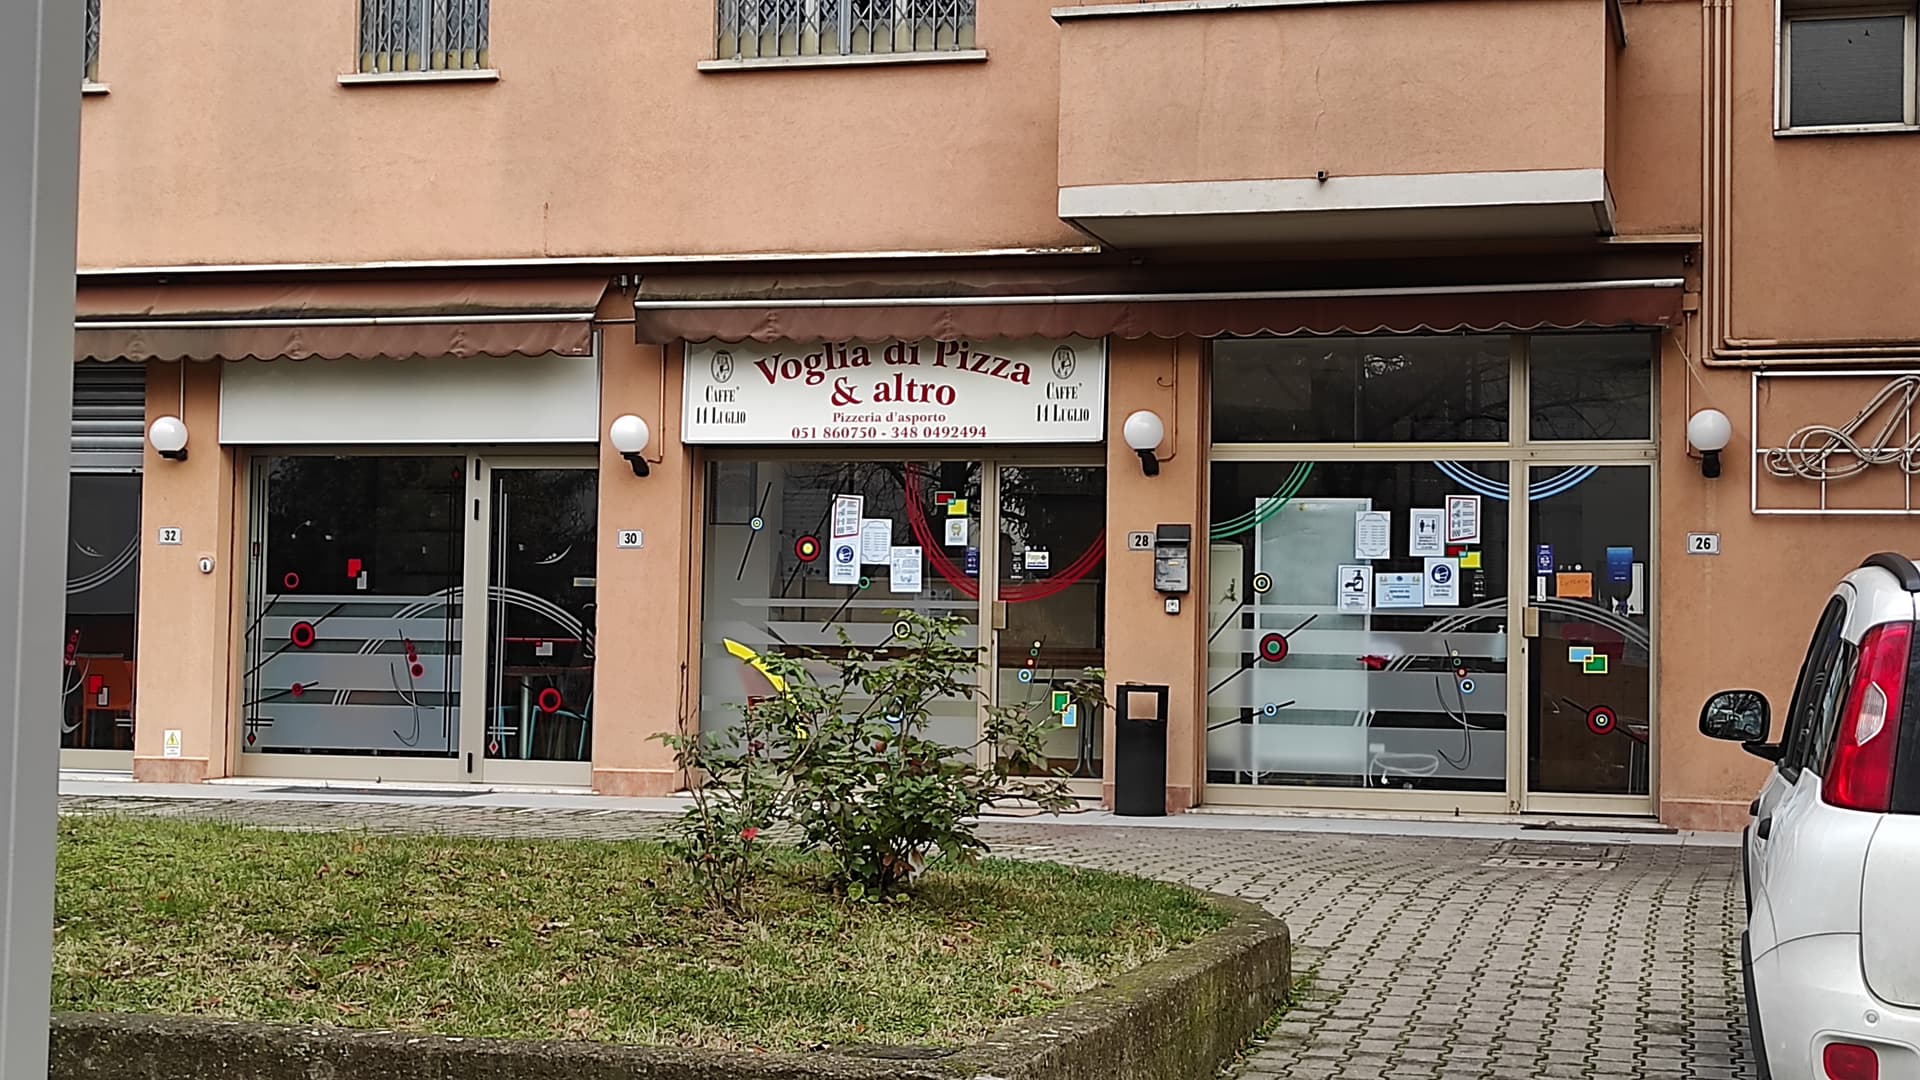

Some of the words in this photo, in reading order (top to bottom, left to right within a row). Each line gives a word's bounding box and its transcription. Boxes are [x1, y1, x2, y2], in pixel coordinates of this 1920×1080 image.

[753, 341, 872, 386] Voglia
[883, 341, 921, 366] di
[932, 341, 1031, 386] Pizza
[831, 376, 863, 407] &
[873, 372, 956, 406] altro
[833, 412, 882, 423] Pizzeria
[885, 412, 946, 425] d'asporto
[791, 427, 817, 439] 051
[823, 427, 877, 439] 860750
[891, 426, 918, 438] 348
[923, 426, 987, 438] 0492494
[164, 530, 177, 541] 32
[624, 532, 637, 545] 30
[1135, 534, 1149, 547] 28
[1695, 537, 1711, 550] 26
